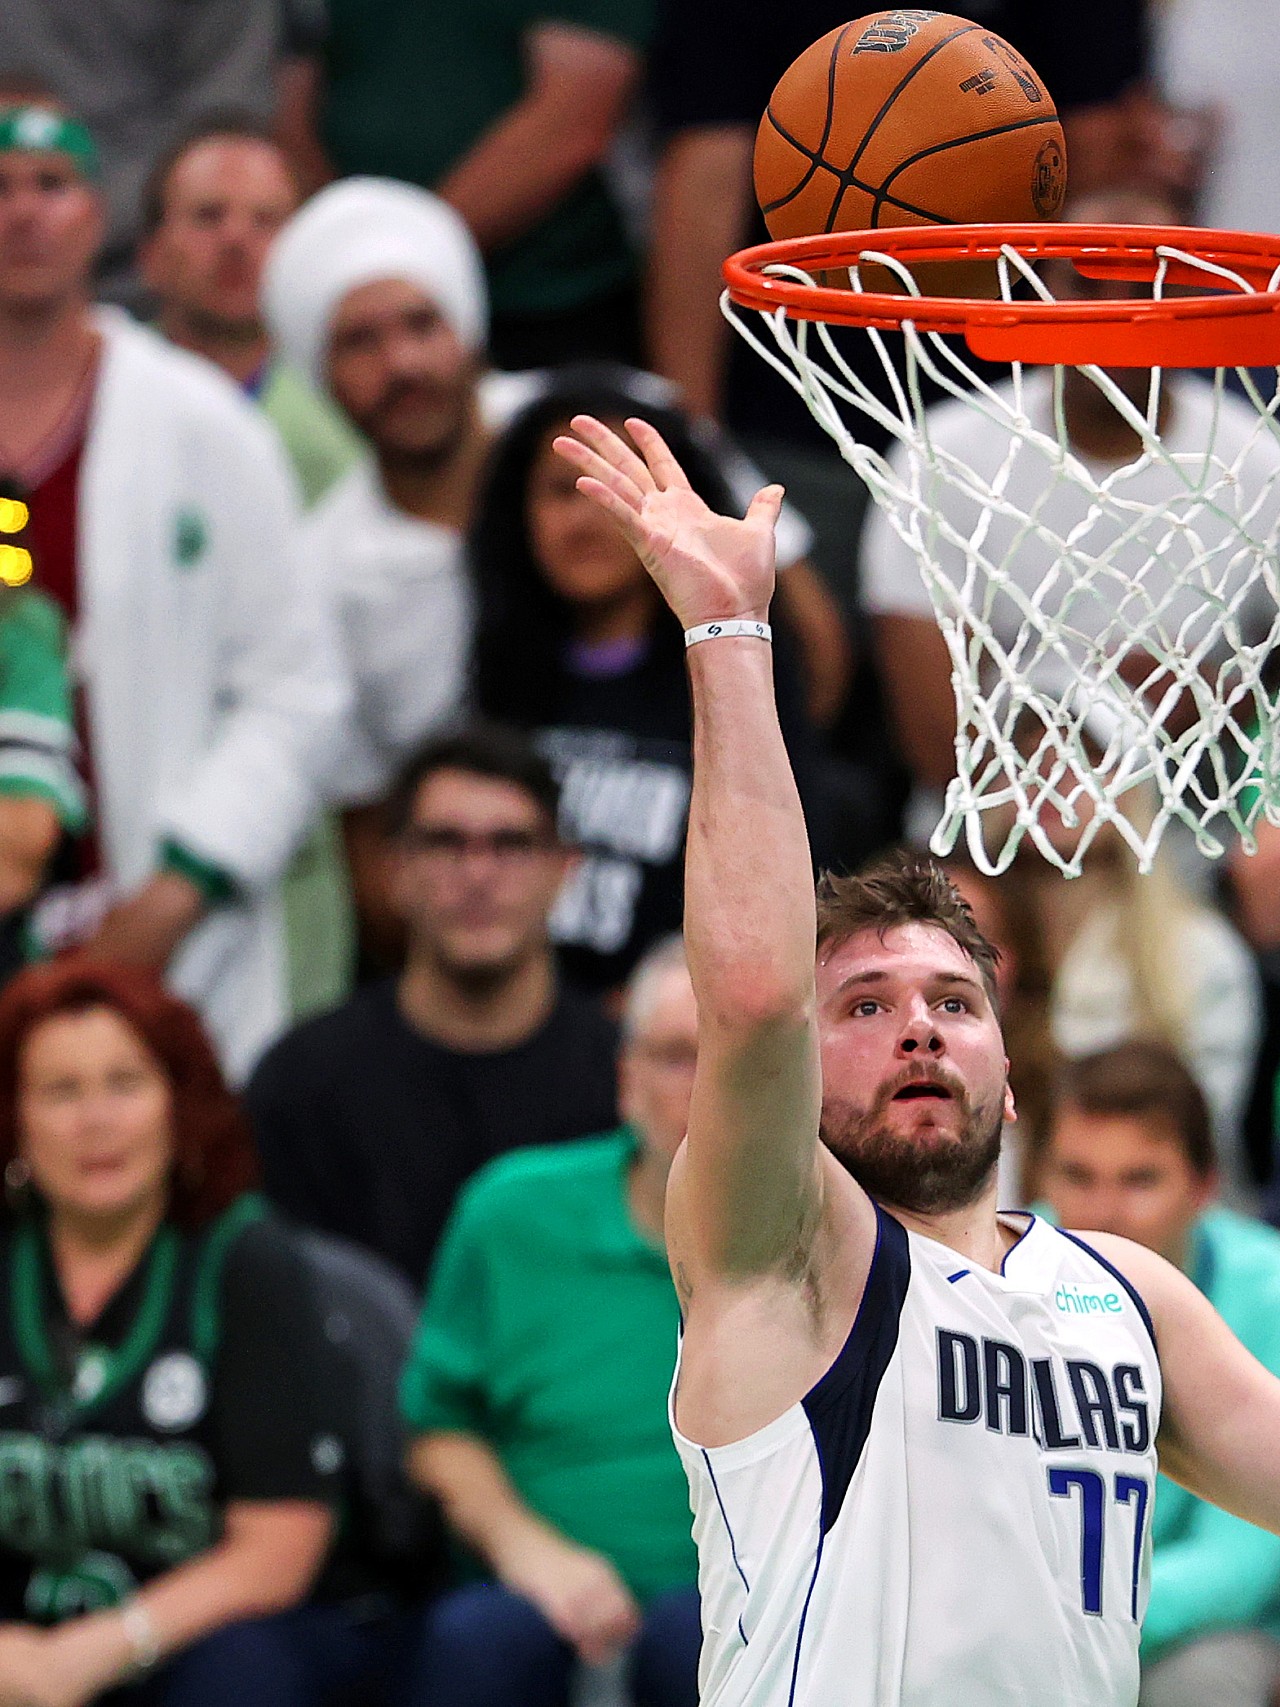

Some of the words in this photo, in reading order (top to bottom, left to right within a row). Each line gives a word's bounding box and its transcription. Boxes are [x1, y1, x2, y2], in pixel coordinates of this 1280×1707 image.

[1055, 1284, 1123, 1315] chime
[935, 1325, 1151, 1456] DALAS
[1046, 1465, 1150, 1622] 77
